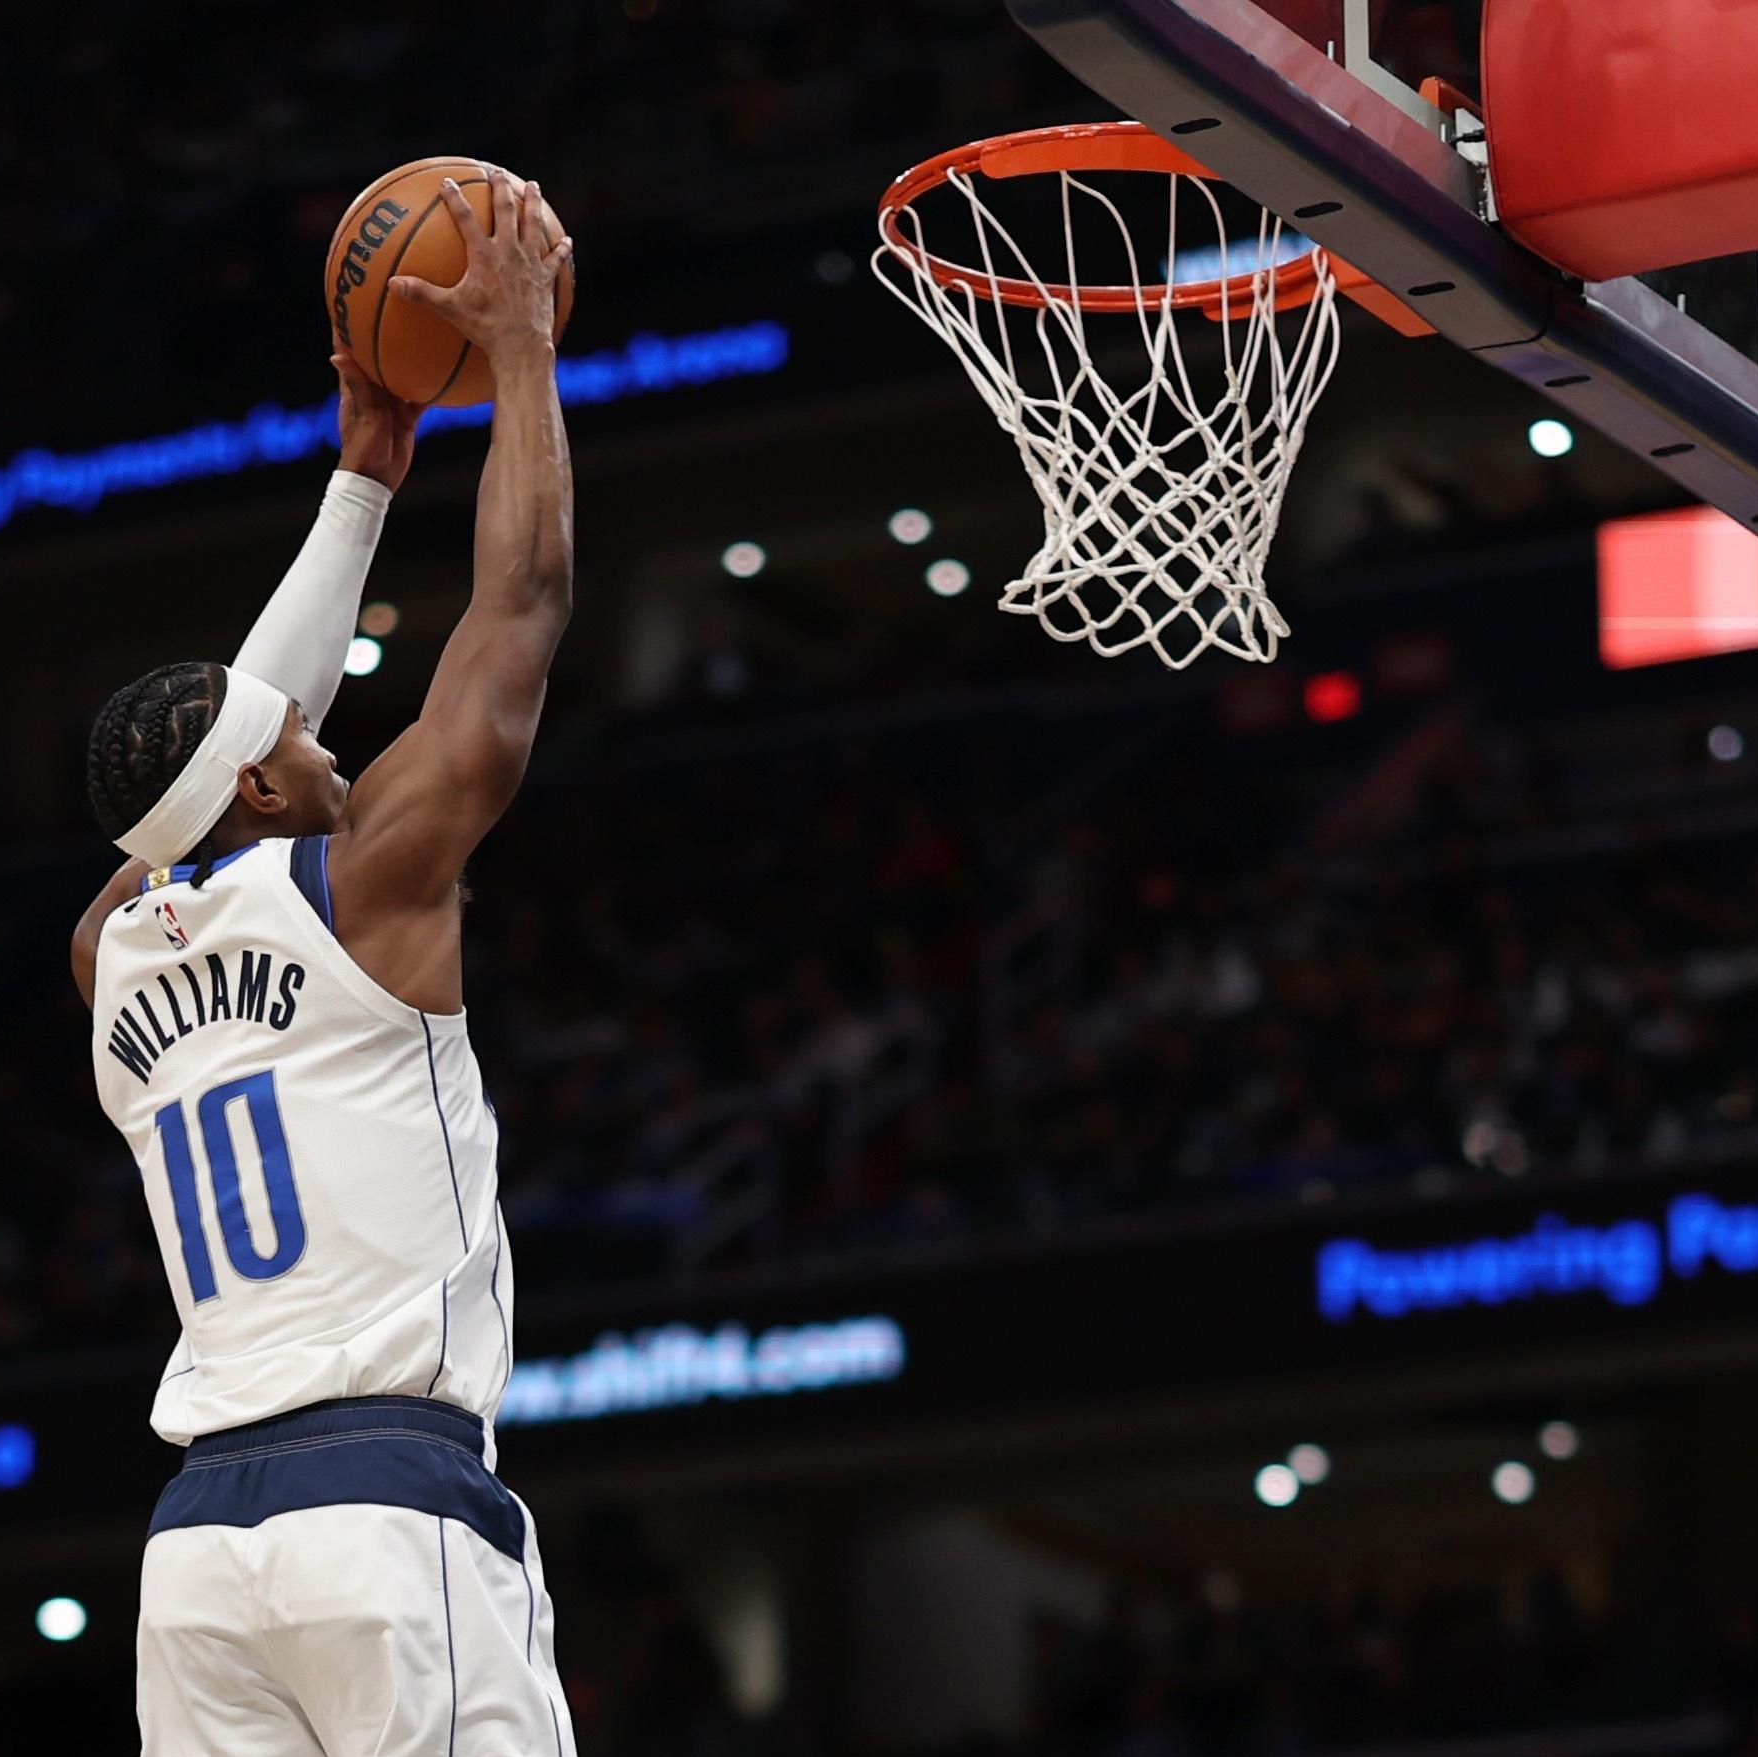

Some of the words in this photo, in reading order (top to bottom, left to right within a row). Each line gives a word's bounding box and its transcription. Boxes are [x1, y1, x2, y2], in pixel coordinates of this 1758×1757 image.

[334, 198, 411, 349] Wilson
[108, 949, 306, 1086] WILLIAMS
[154, 1067, 308, 1308] 10
[1316, 1211, 1662, 1322] Powering
